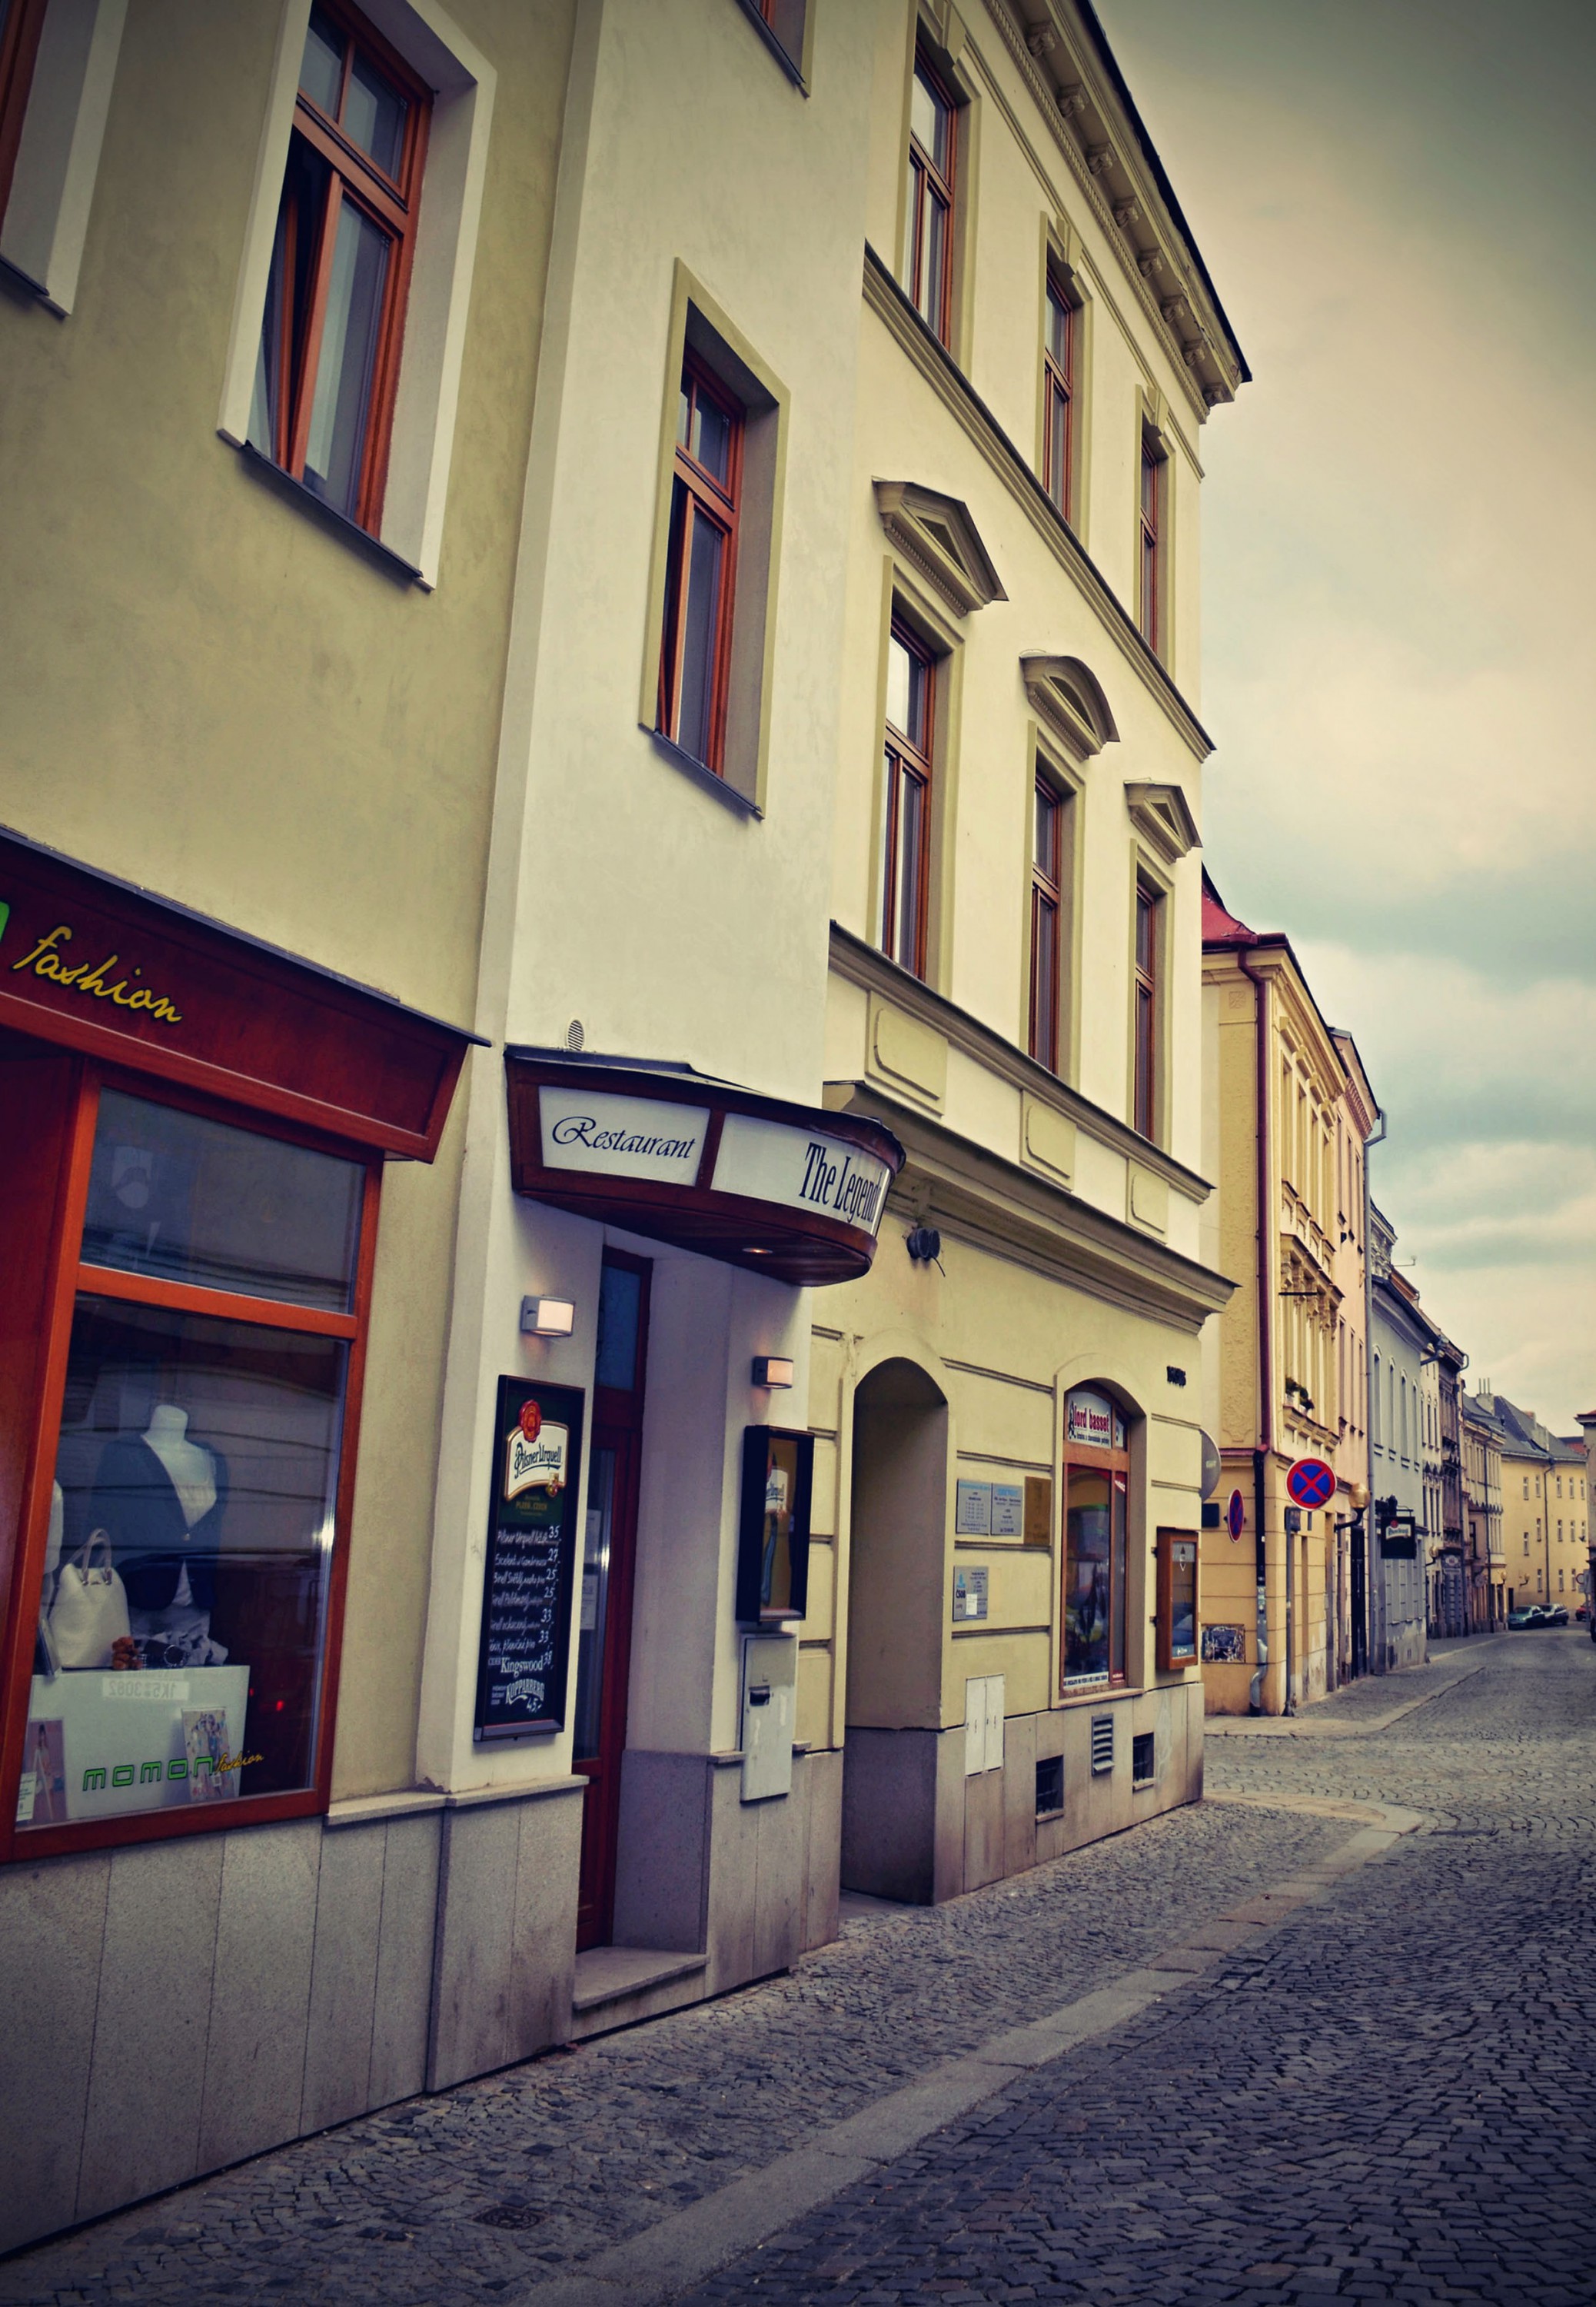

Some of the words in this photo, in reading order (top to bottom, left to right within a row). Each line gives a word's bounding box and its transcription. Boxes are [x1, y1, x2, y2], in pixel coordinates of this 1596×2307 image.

[12, 925, 183, 1023] fashion
[552, 1117, 695, 1159] Restaurant
[799, 1142, 836, 1205] The
[1074, 1405, 1087, 1428] lord
[1089, 1408, 1109, 1433] basset
[514, 1442, 540, 1480] Pilsner
[538, 1443, 562, 1470] Urquell
[500, 1655, 544, 1678] Kingswood
[506, 1679, 545, 1704] KOPPARBERG
[214, 1751, 264, 1774] fashion
